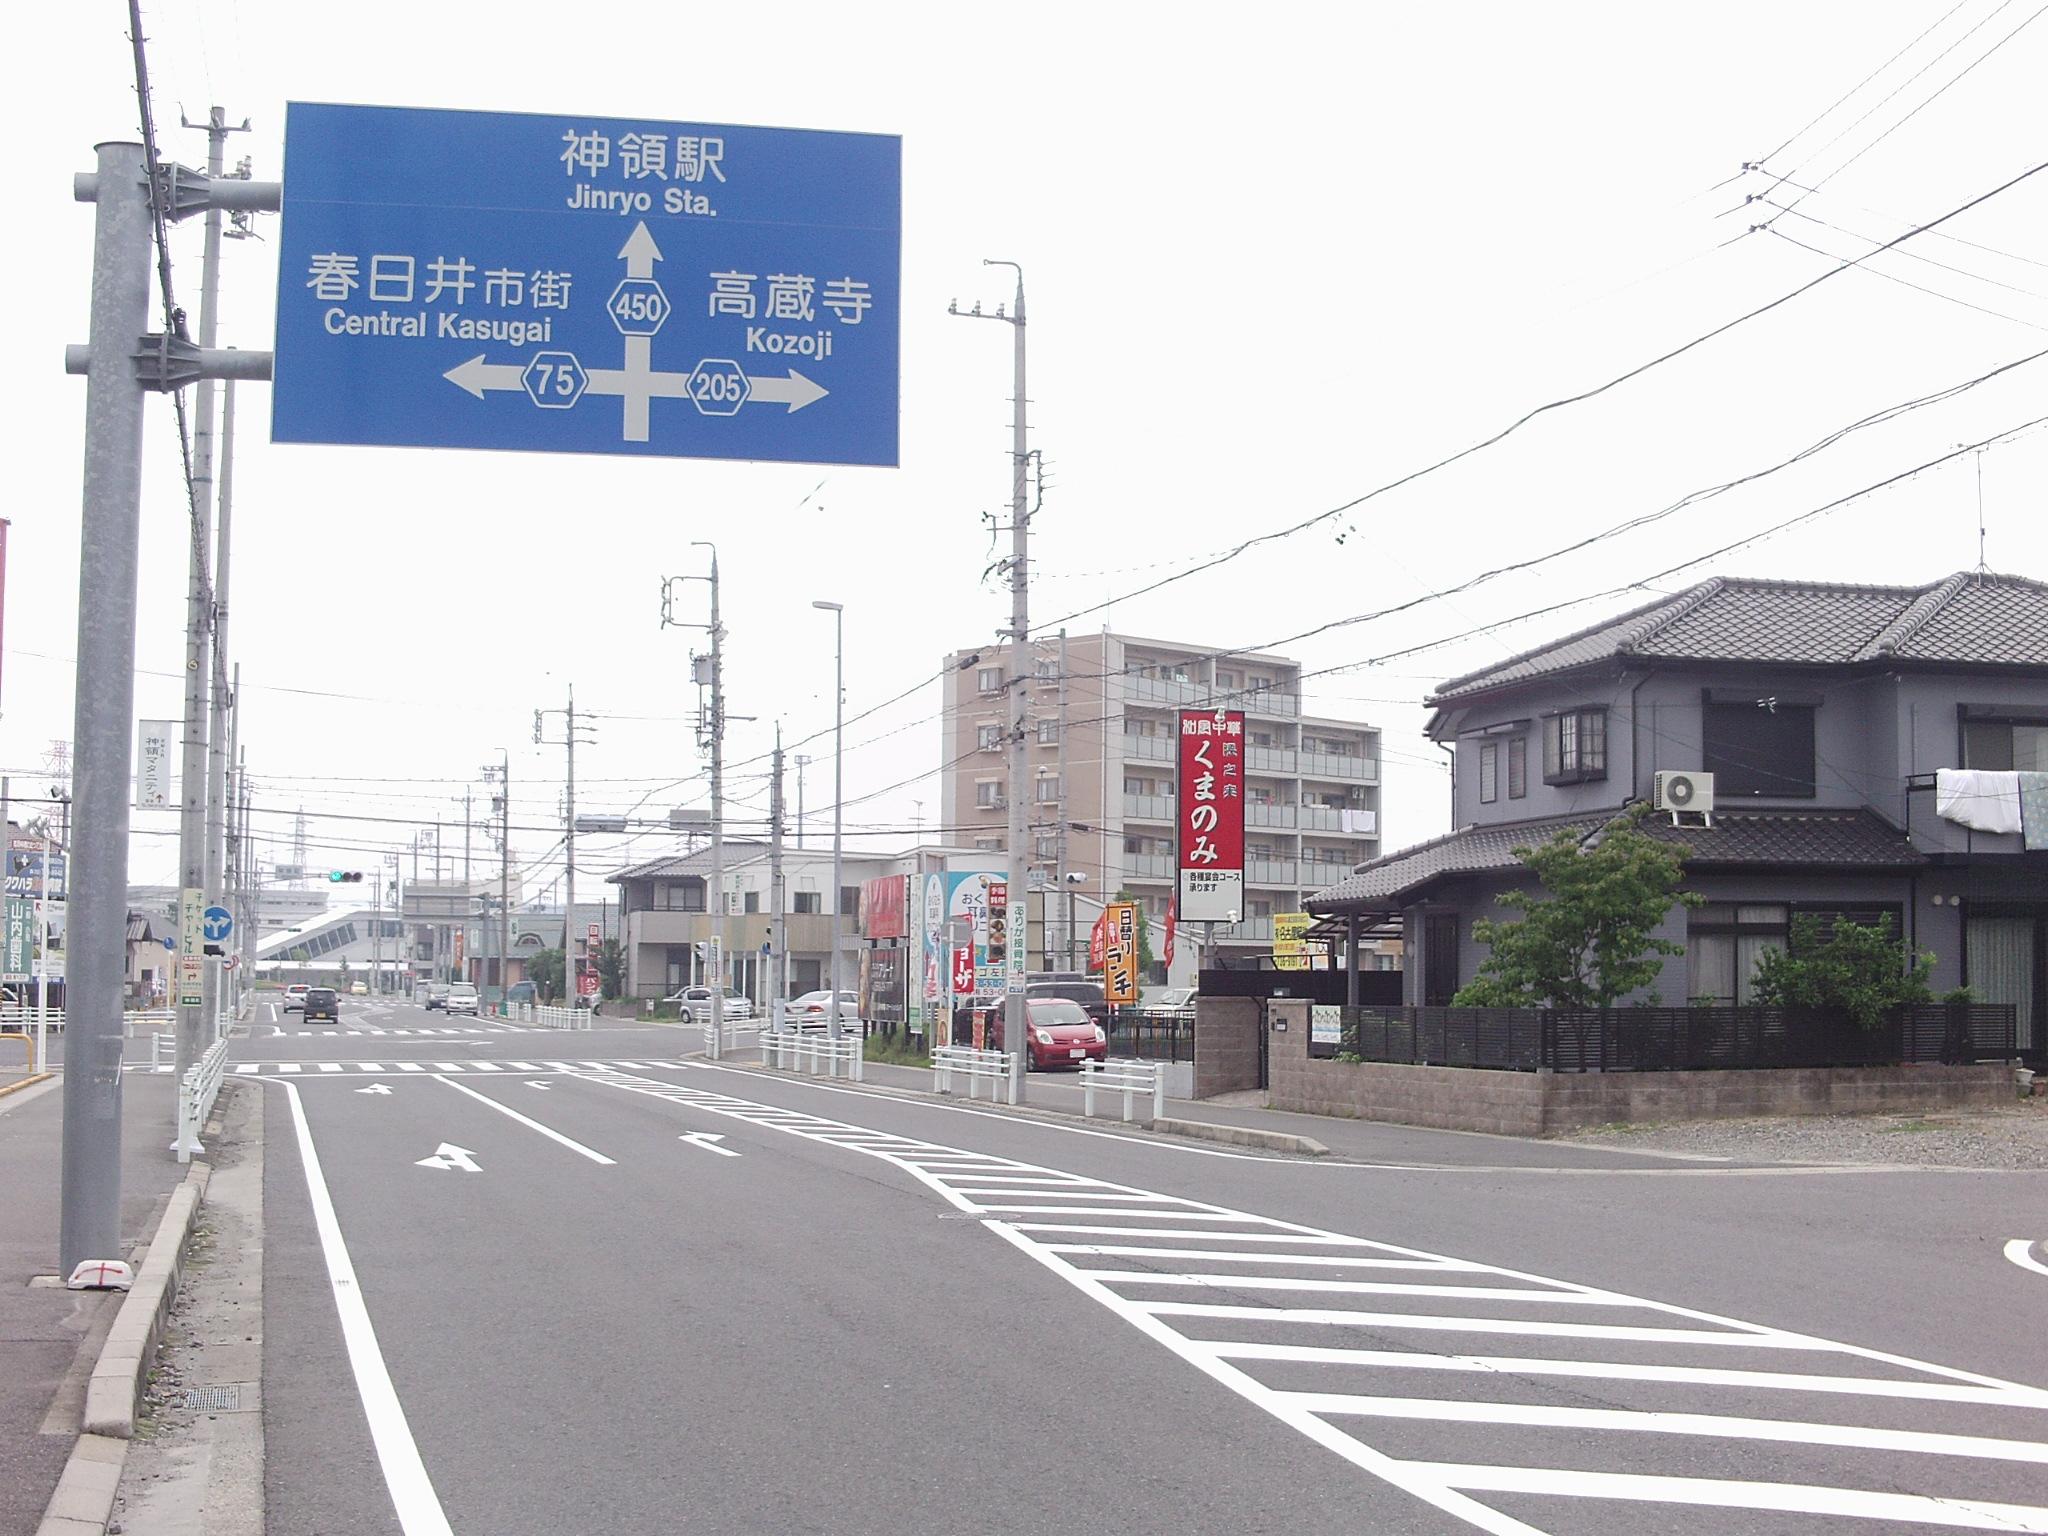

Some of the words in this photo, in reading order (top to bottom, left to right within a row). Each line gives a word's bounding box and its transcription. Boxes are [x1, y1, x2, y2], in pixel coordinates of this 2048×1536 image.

[560, 129, 726, 183] 神領駅
[567, 184, 652, 216] Jinryo
[664, 188, 717, 217] Sta.
[306, 252, 573, 310] 春日井市街
[709, 270, 872, 325] 高蔵寺
[324, 307, 426, 337] Central
[438, 312, 551, 347] Kasugai
[616, 293, 661, 321] 450
[746, 327, 832, 361] Kozoji
[536, 364, 574, 395] 75
[696, 373, 740, 401] 205
[1191, 740, 1217, 864] くまのみ
[1107, 947, 1132, 995] ランチ
